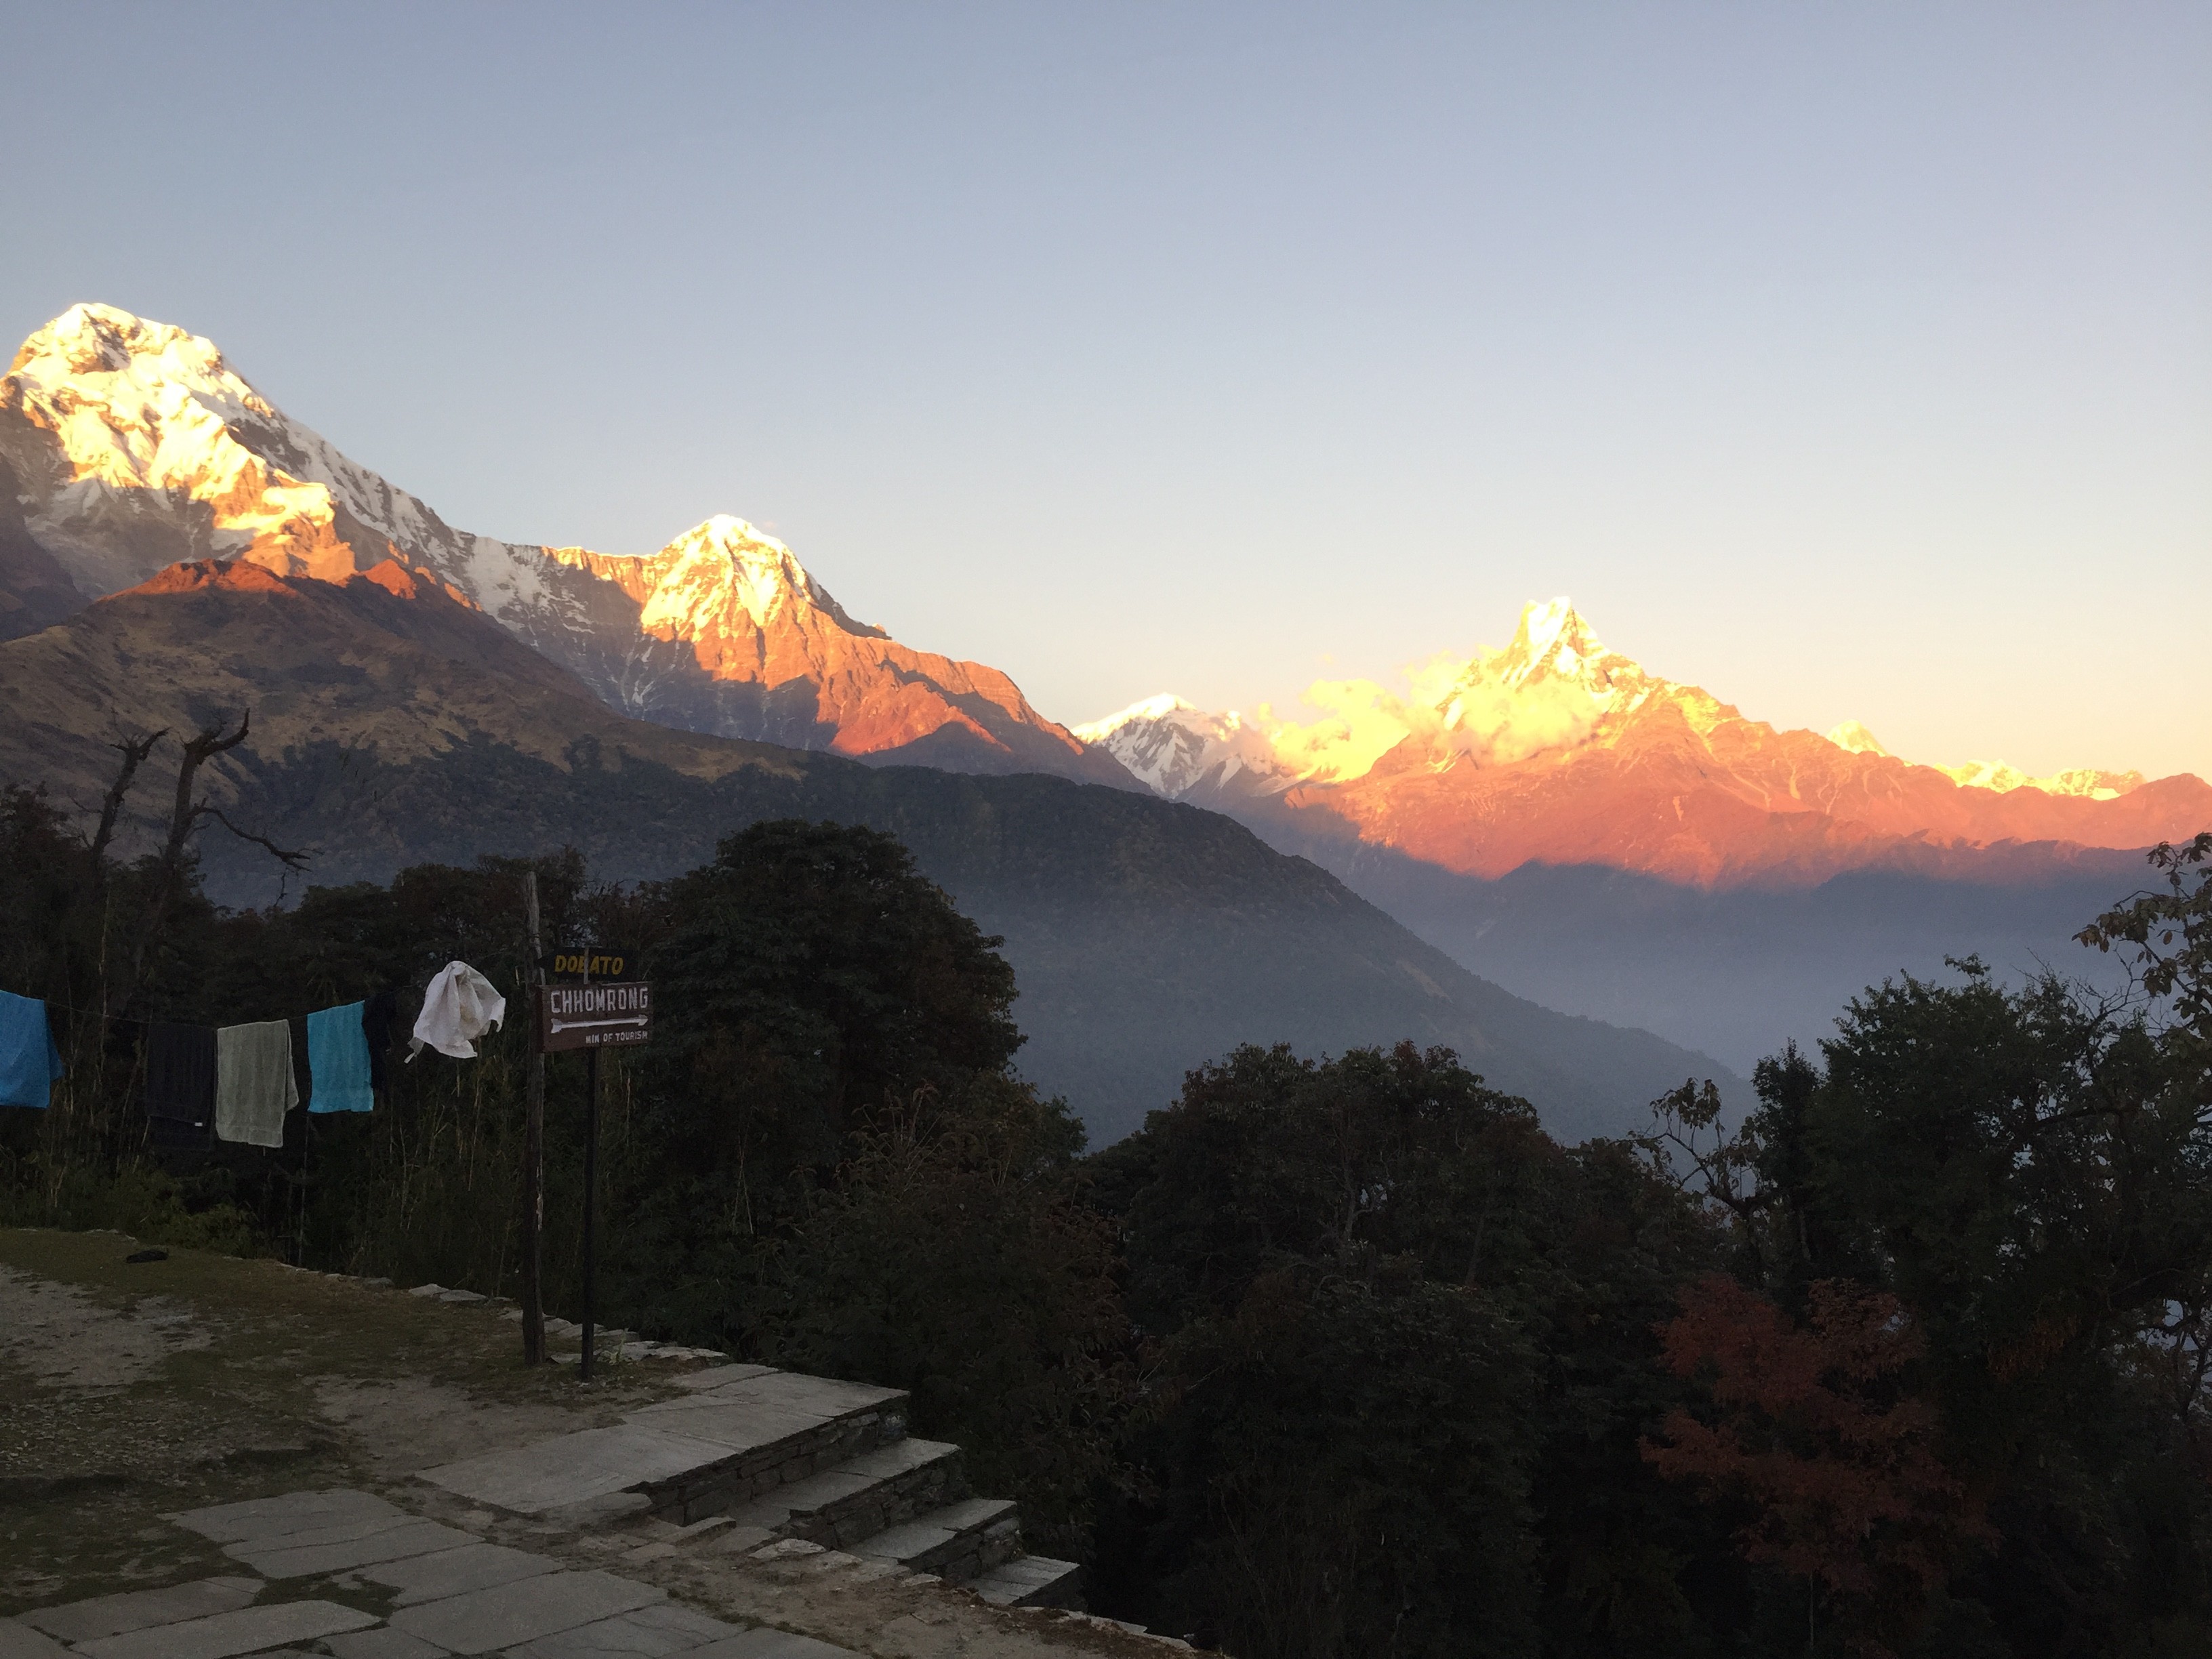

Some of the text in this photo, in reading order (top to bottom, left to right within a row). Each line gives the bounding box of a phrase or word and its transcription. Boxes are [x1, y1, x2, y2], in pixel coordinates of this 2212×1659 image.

[554, 954, 625, 975] DOBATO
[550, 986, 649, 1014] CHHOMRONG
[586, 1030, 648, 1044] MIN OF TOURISM
